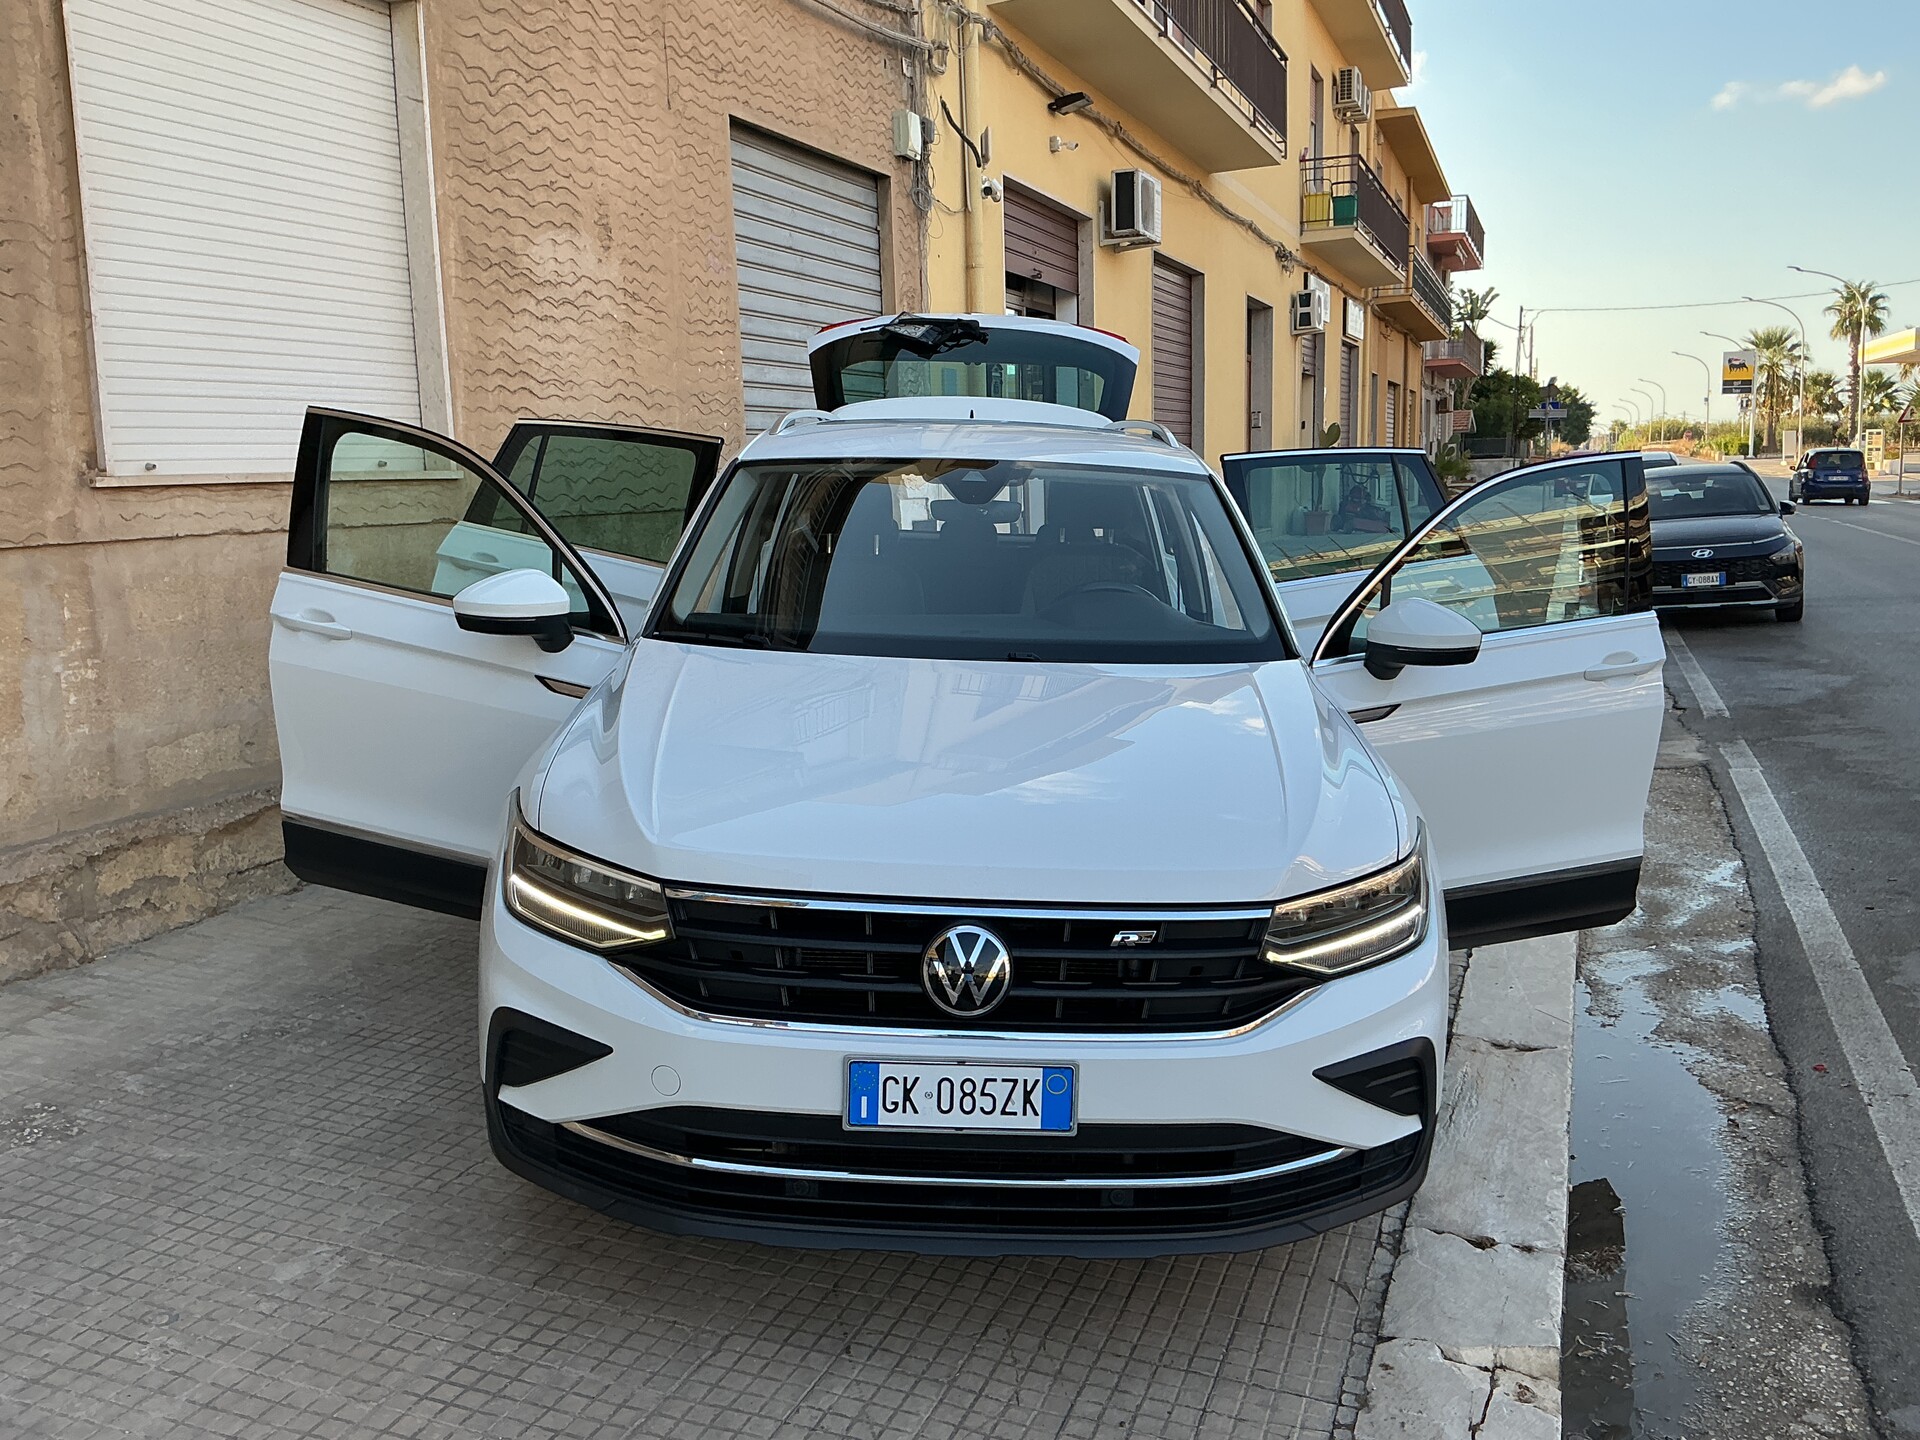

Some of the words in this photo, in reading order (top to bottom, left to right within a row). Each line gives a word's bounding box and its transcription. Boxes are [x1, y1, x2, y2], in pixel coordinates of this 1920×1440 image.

[1742, 398, 1748, 407] T
[881, 1075, 920, 1115] GK
[936, 1076, 1041, 1117] 085ZK
